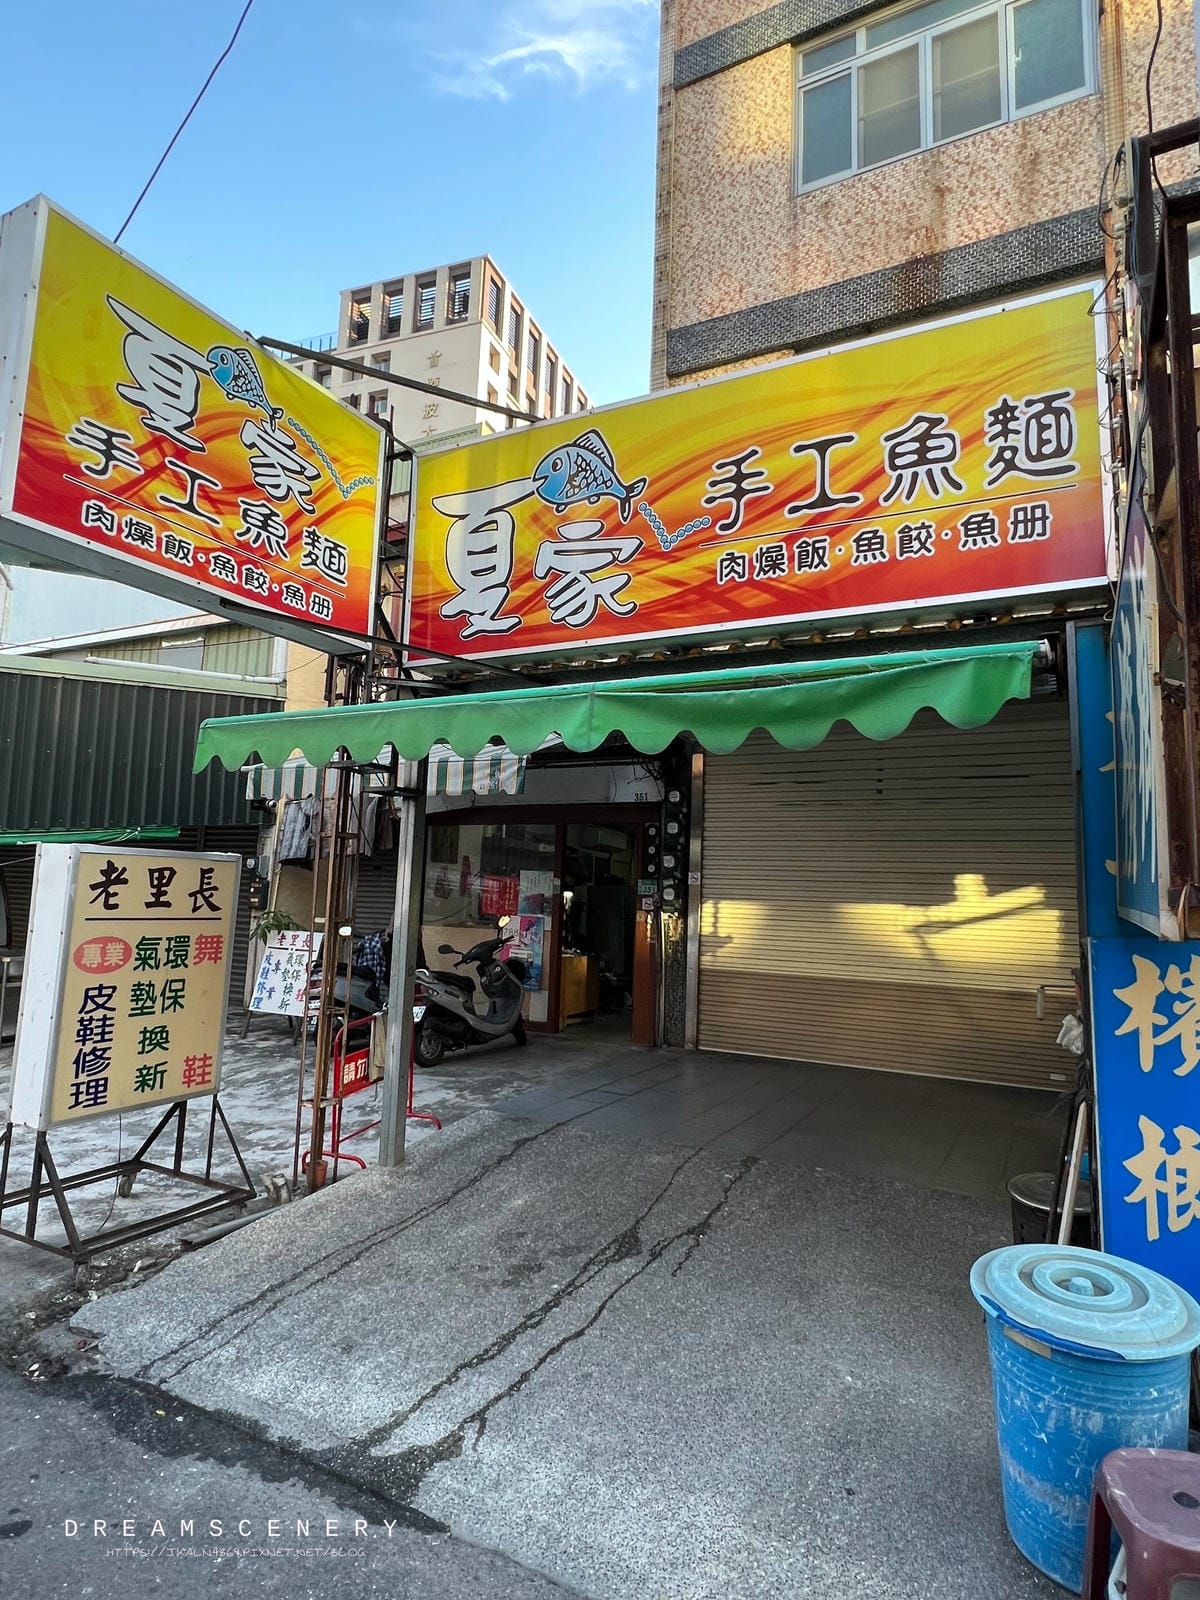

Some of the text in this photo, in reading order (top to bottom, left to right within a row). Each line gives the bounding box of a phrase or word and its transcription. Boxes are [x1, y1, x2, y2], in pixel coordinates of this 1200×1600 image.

[106, 294, 321, 514] 夏家
[702, 388, 1080, 537] 手工魚麵
[66, 416, 349, 587] 手工魚麵
[432, 478, 645, 641] 夏家
[634, 792, 648, 802] 351
[88, 859, 223, 913] 老里長
[276, 932, 311, 948] 老里長
[80, 941, 126, 967] 專業
[67, 983, 118, 1110] 皮鞋修理
